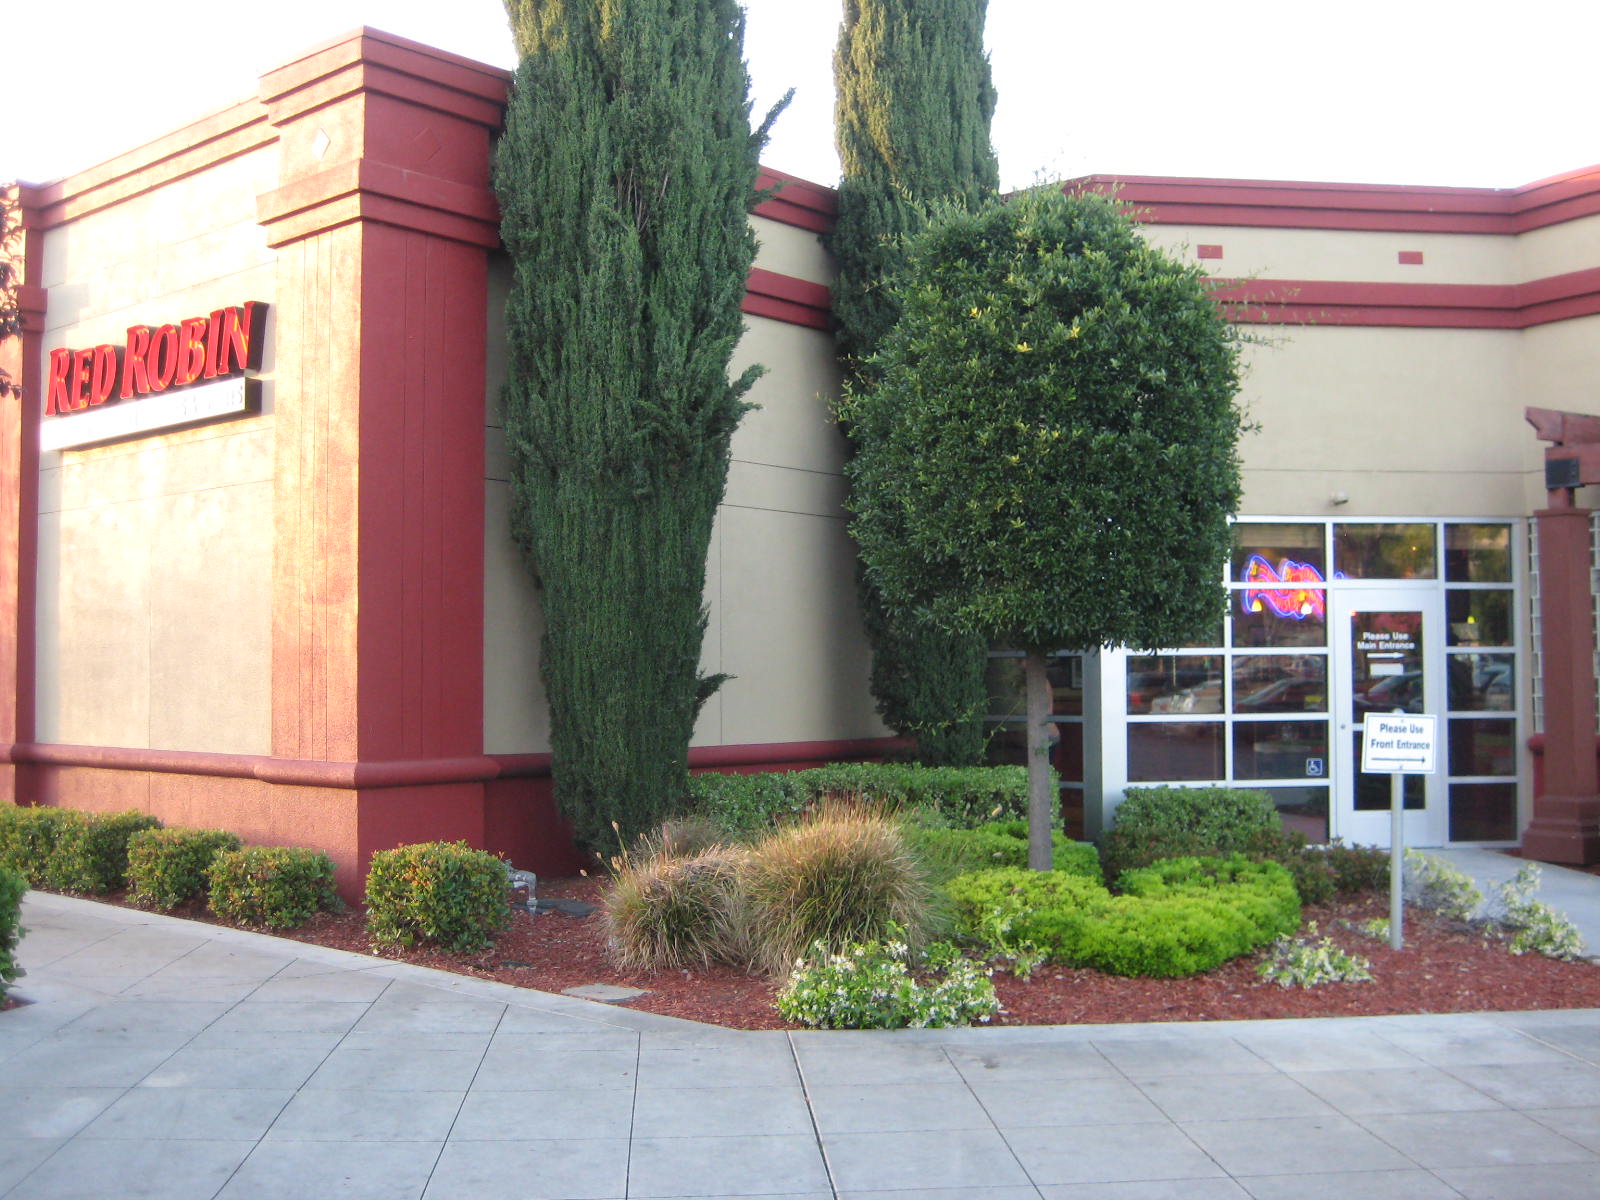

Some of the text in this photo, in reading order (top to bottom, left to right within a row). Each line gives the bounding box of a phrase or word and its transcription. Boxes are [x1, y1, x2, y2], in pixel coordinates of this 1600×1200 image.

[46, 344, 118, 417] RED
[120, 301, 258, 398] ROBIN
[1363, 631, 1409, 641] Please Use
[1357, 641, 1416, 650] Main Entrance
[1379, 722, 1424, 734] Please Use
[1370, 738, 1431, 750] Front Entrance
